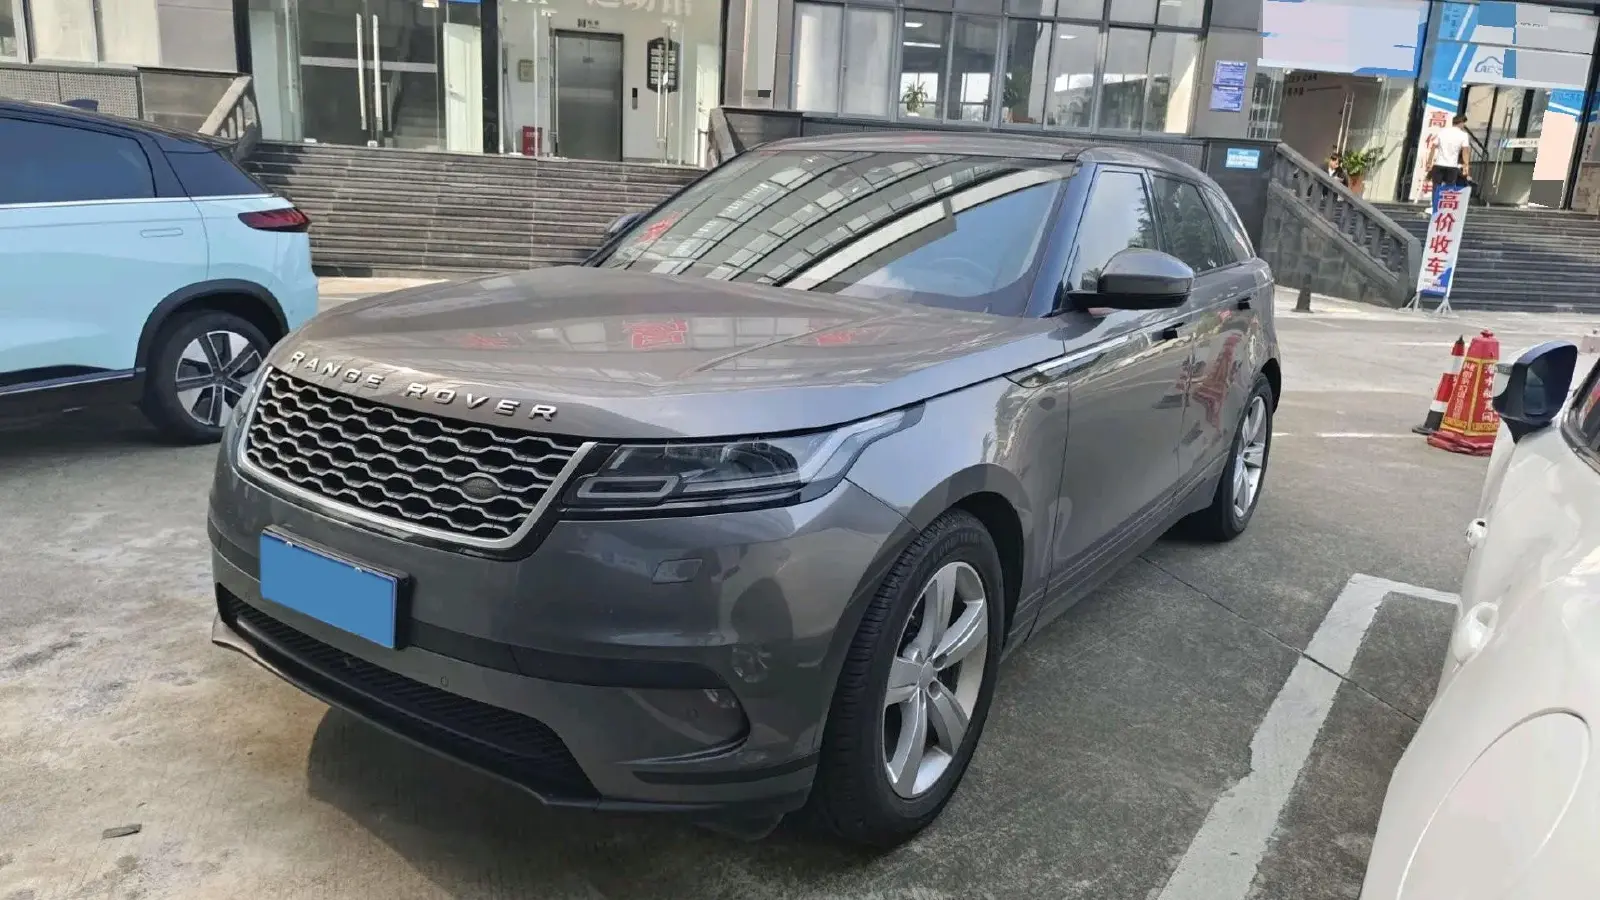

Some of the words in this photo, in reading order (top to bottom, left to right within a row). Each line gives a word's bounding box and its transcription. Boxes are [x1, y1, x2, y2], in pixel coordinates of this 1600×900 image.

[1426, 190, 1462, 276] 高价收车
[290, 350, 385, 390] RANGE
[404, 383, 558, 421] ROVER
